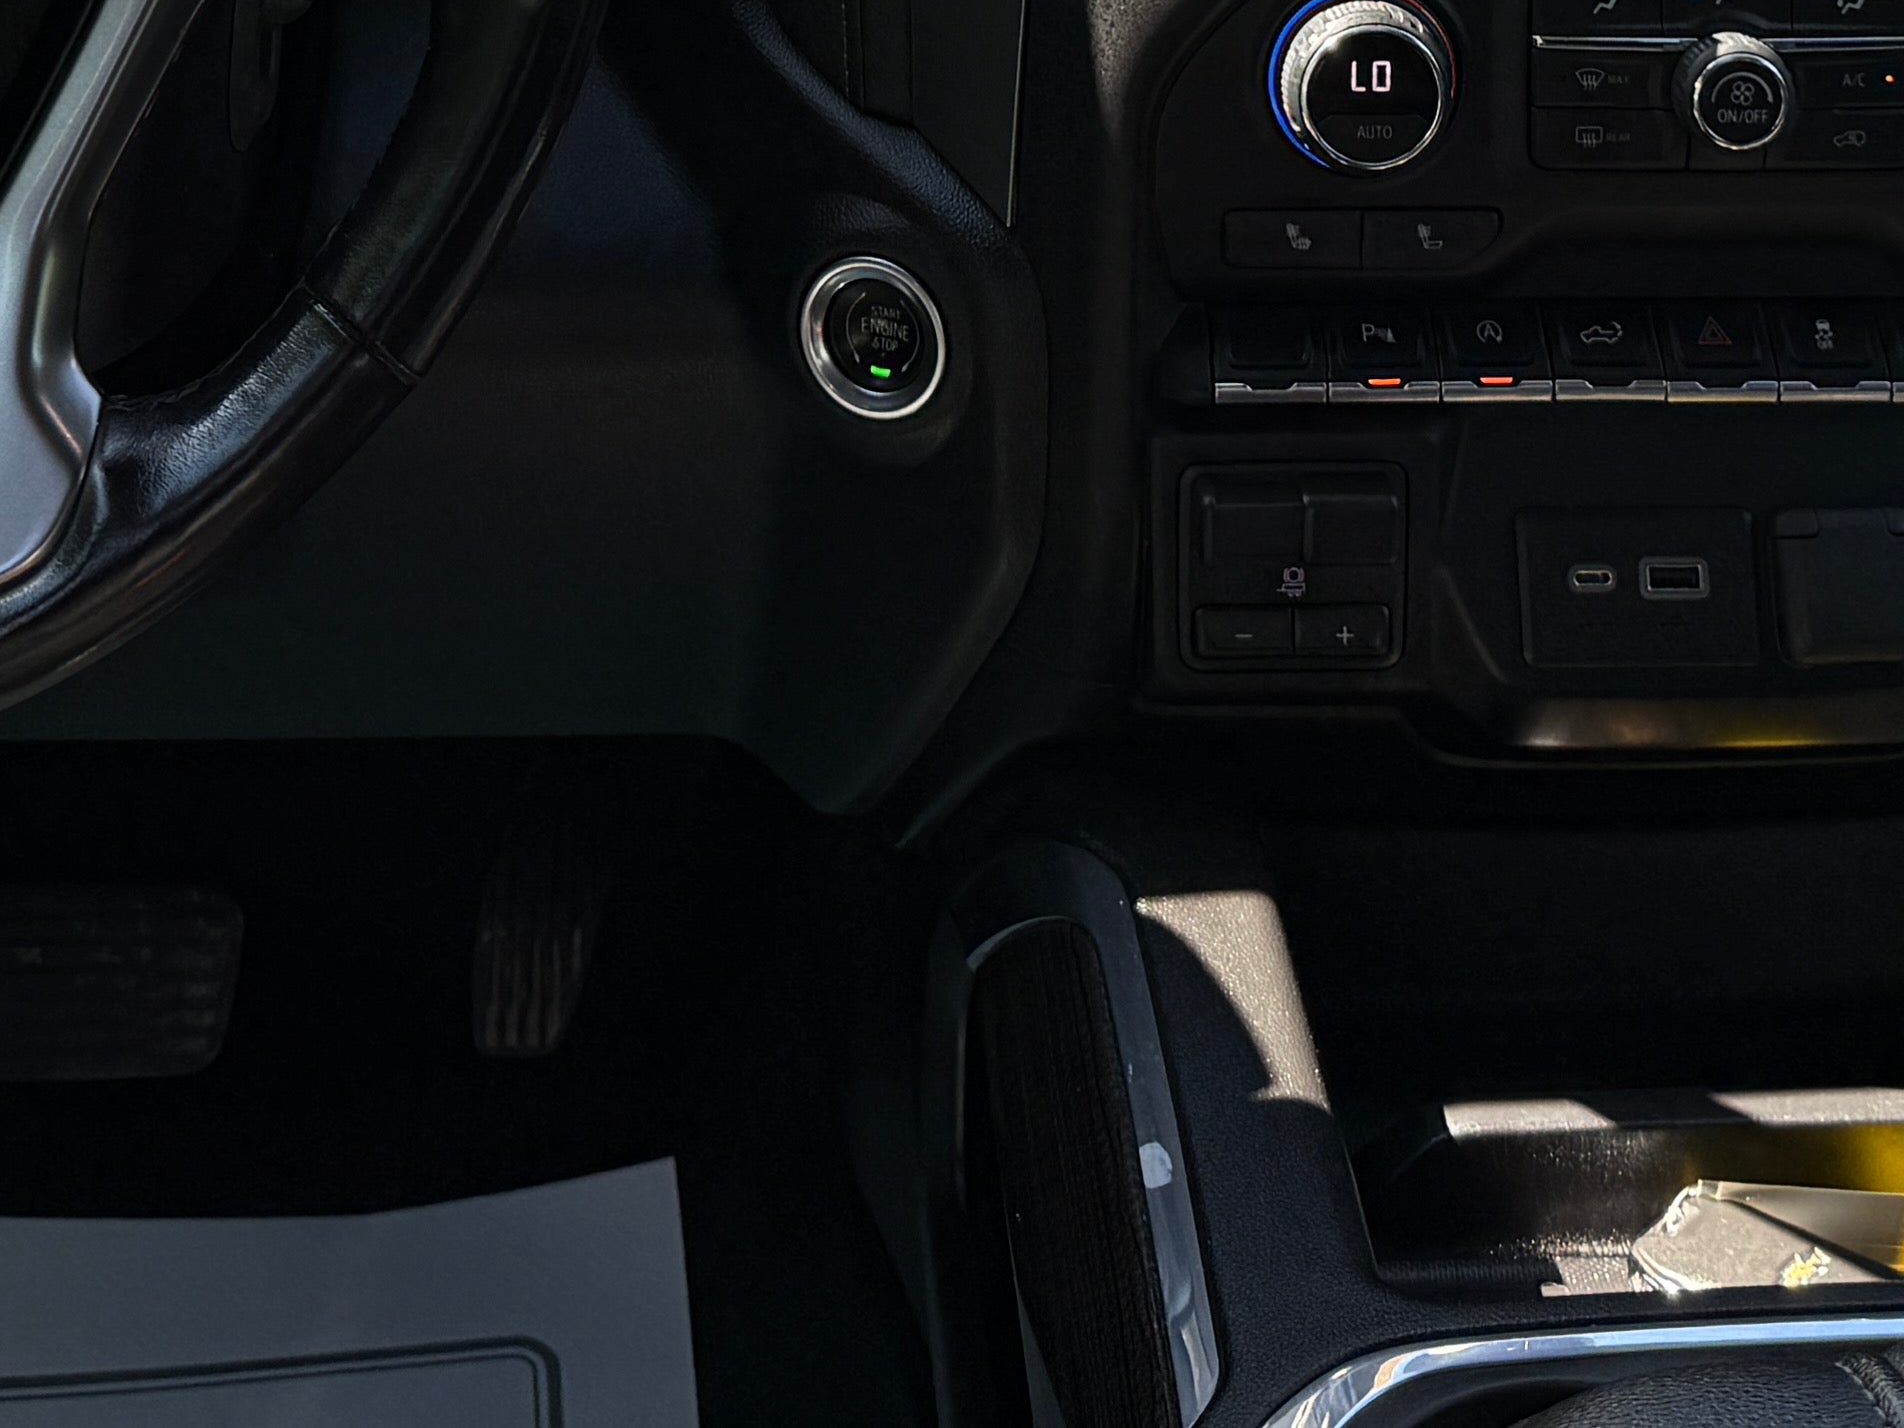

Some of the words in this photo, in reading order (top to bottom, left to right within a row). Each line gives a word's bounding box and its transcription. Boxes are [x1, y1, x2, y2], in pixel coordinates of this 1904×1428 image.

[1350, 59, 1393, 95] LO
[1841, 72, 1866, 88] A/C
[1716, 108, 1770, 124] ON/OFF
[1356, 123, 1393, 141] AUTO
[860, 317, 910, 343] ENGINE
[871, 337, 899, 353] STOP
